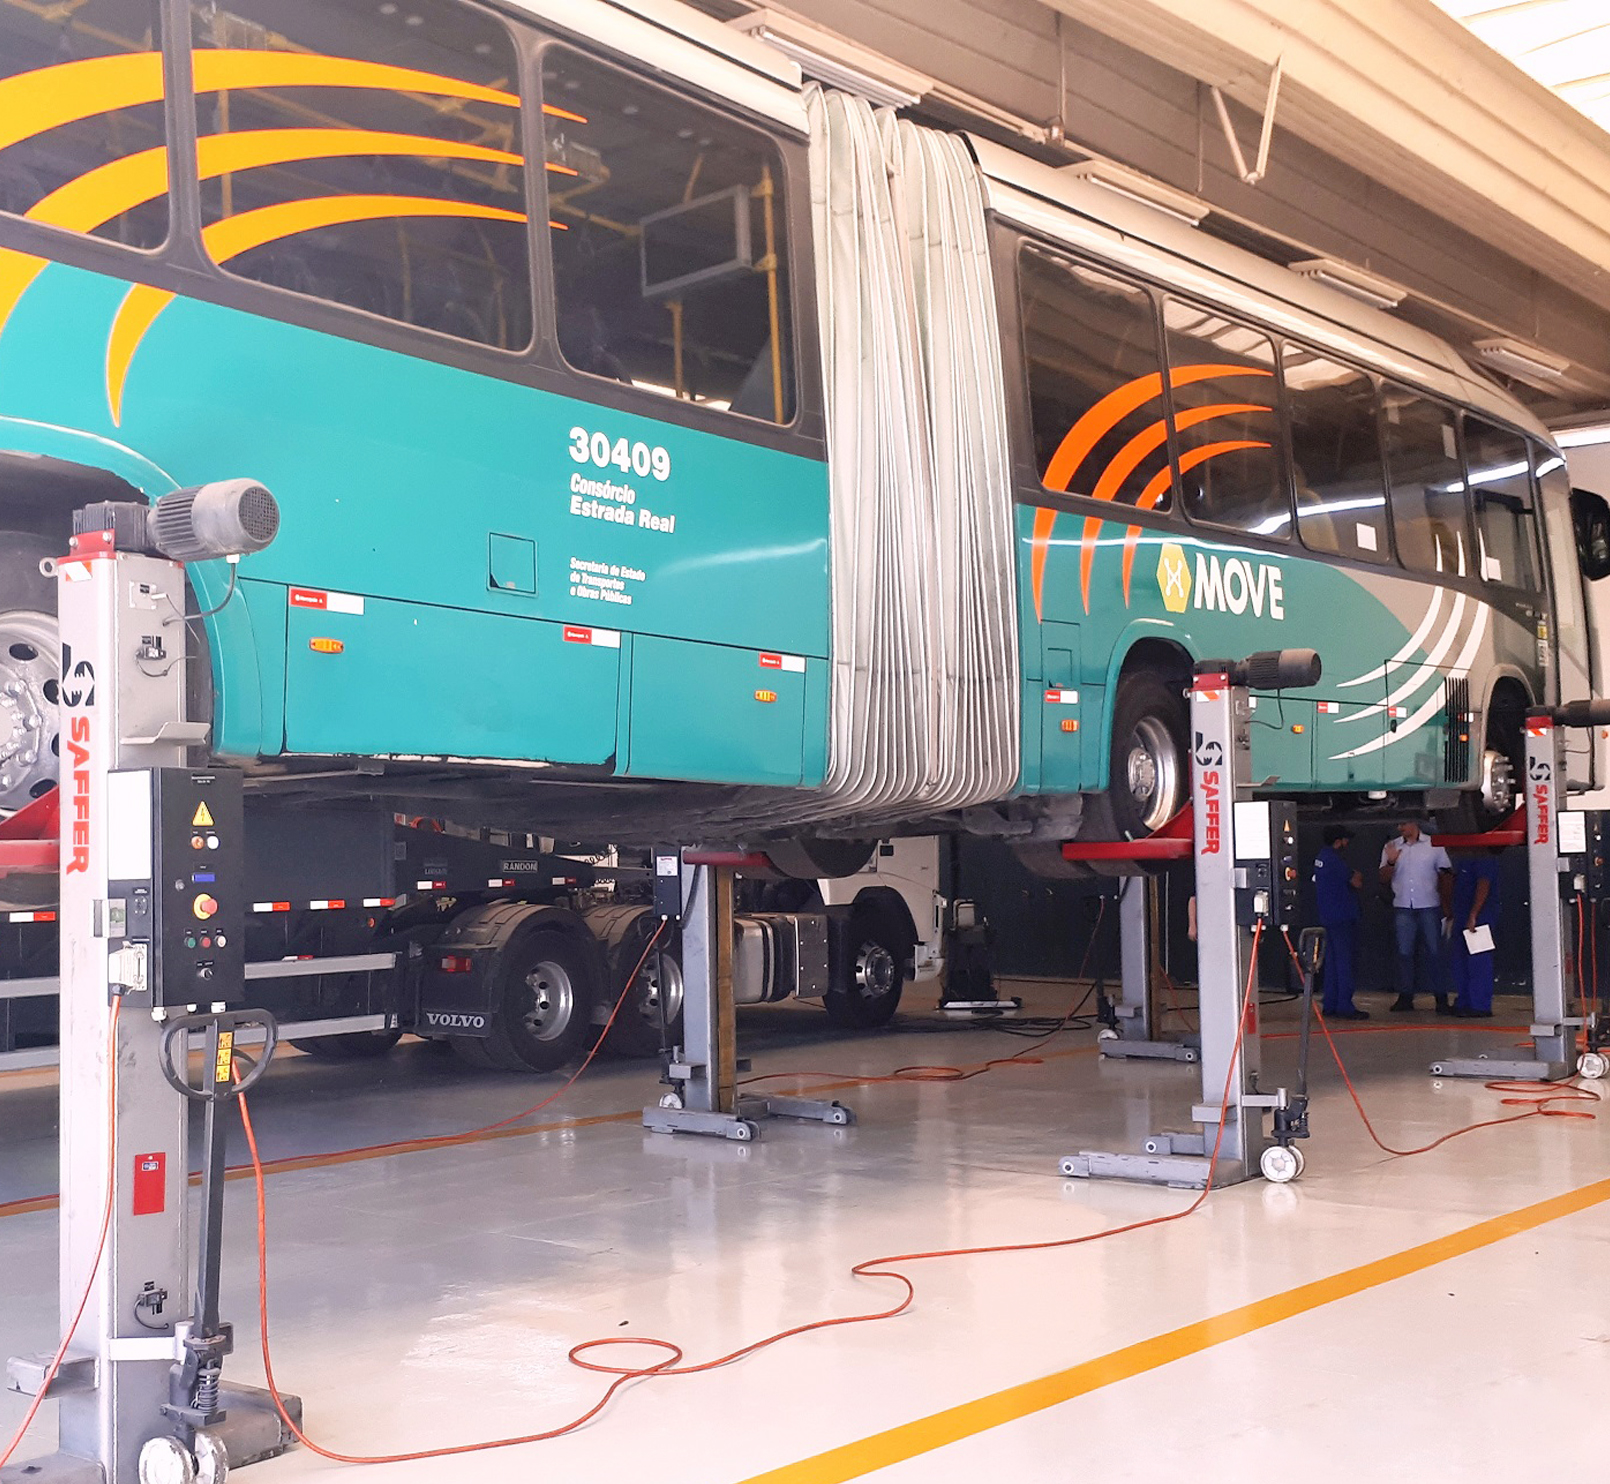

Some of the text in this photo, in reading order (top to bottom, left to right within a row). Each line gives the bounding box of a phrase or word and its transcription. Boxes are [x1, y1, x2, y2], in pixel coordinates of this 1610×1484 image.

[568, 426, 671, 482] 30409
[570, 472, 636, 505] Consórcio
[570, 494, 676, 534] Estrada Real
[569, 556, 647, 582] Secretaria de Estado
[569, 570, 581, 583] de
[1193, 552, 1285, 621] MOVE
[66, 716, 90, 876] SAFFER
[1200, 770, 1221, 856] SAFFER
[1532, 784, 1549, 845] SAFFER
[503, 861, 538, 872] RANDON
[426, 1012, 486, 1029] VOLVO
